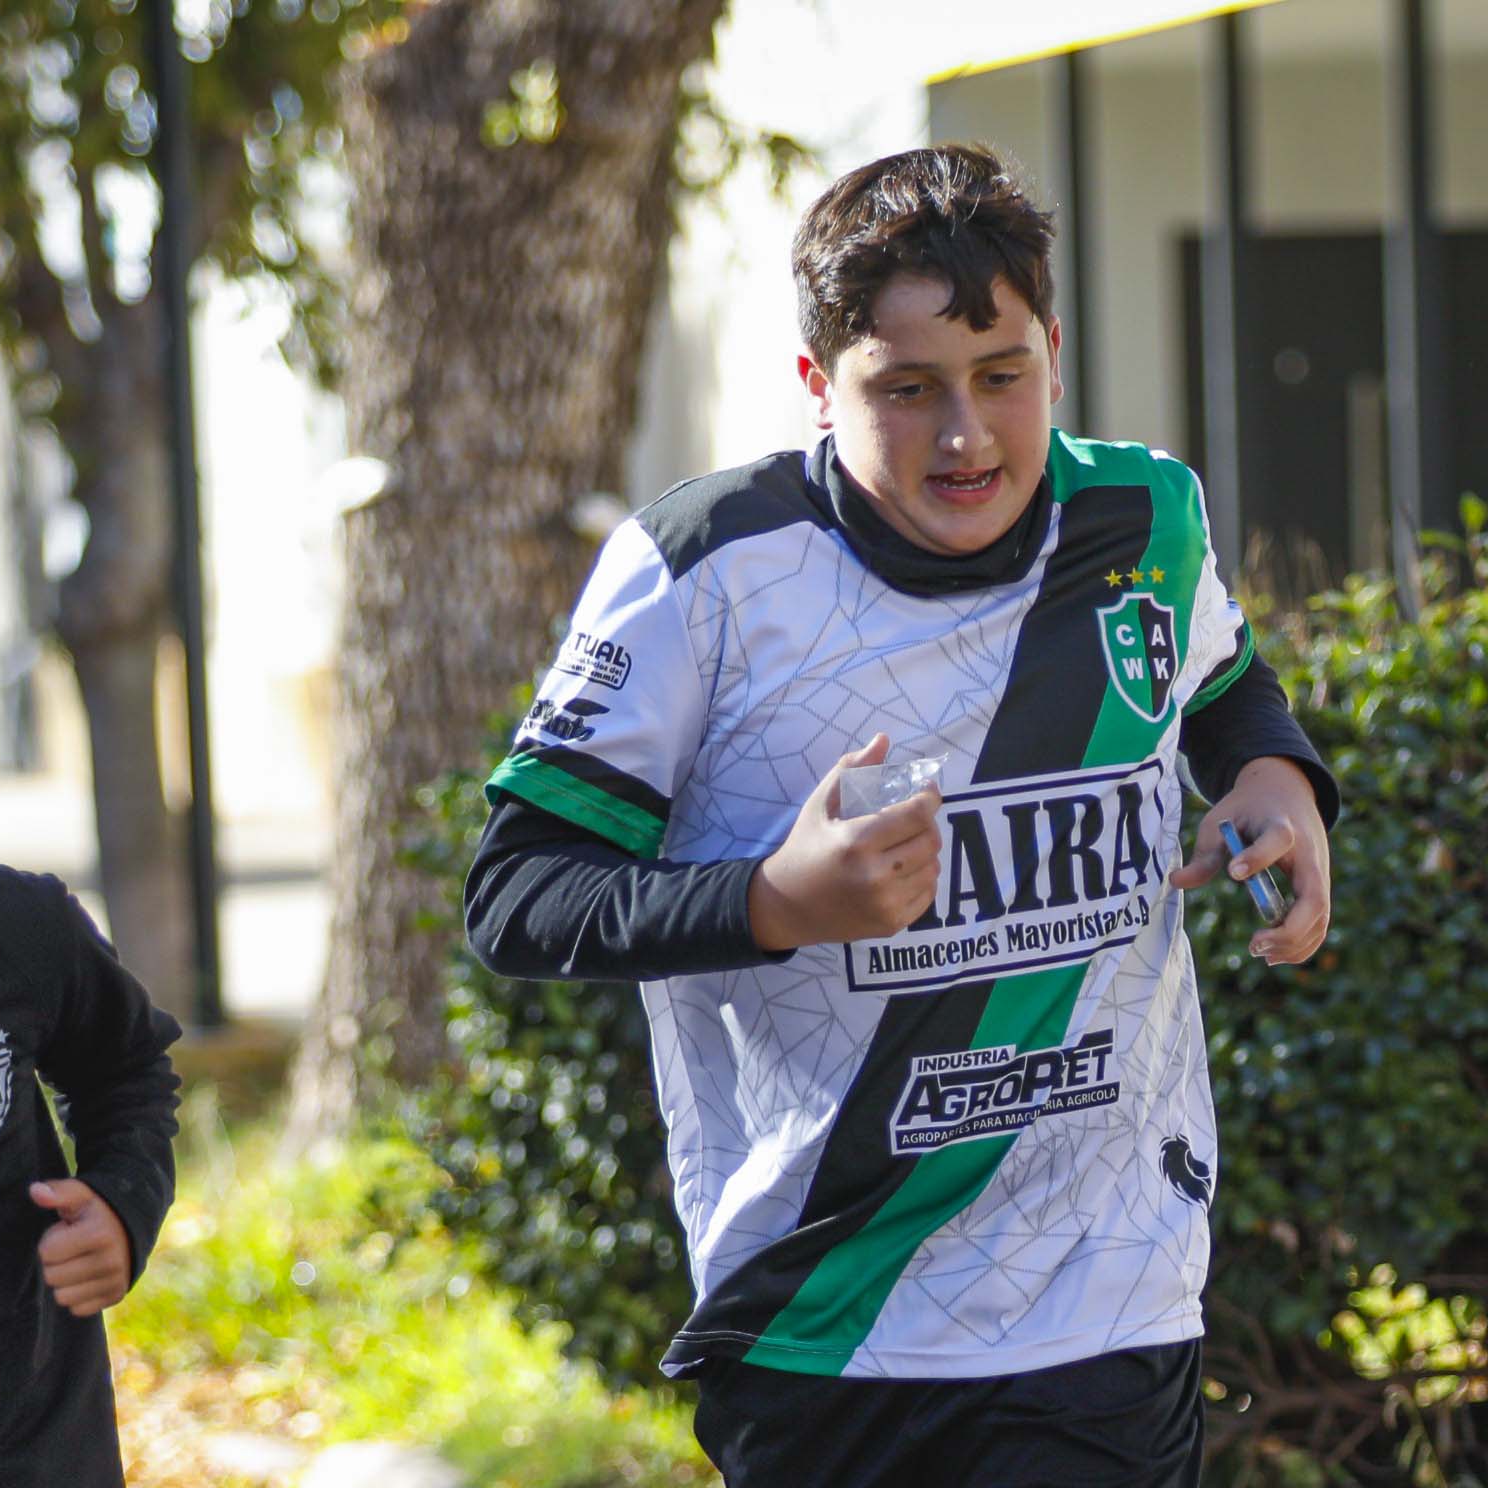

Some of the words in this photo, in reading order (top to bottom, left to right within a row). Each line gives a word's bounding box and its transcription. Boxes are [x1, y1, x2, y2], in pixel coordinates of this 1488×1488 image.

[574, 632, 627, 668] TUAL
[907, 782, 1150, 932] AIRA
[868, 931, 999, 974] Almacenes
[917, 1048, 1010, 1073] INDUSTRIA
[973, 1114, 1002, 1131] PARA
[1066, 1088, 1117, 1107] AGRICOLA
